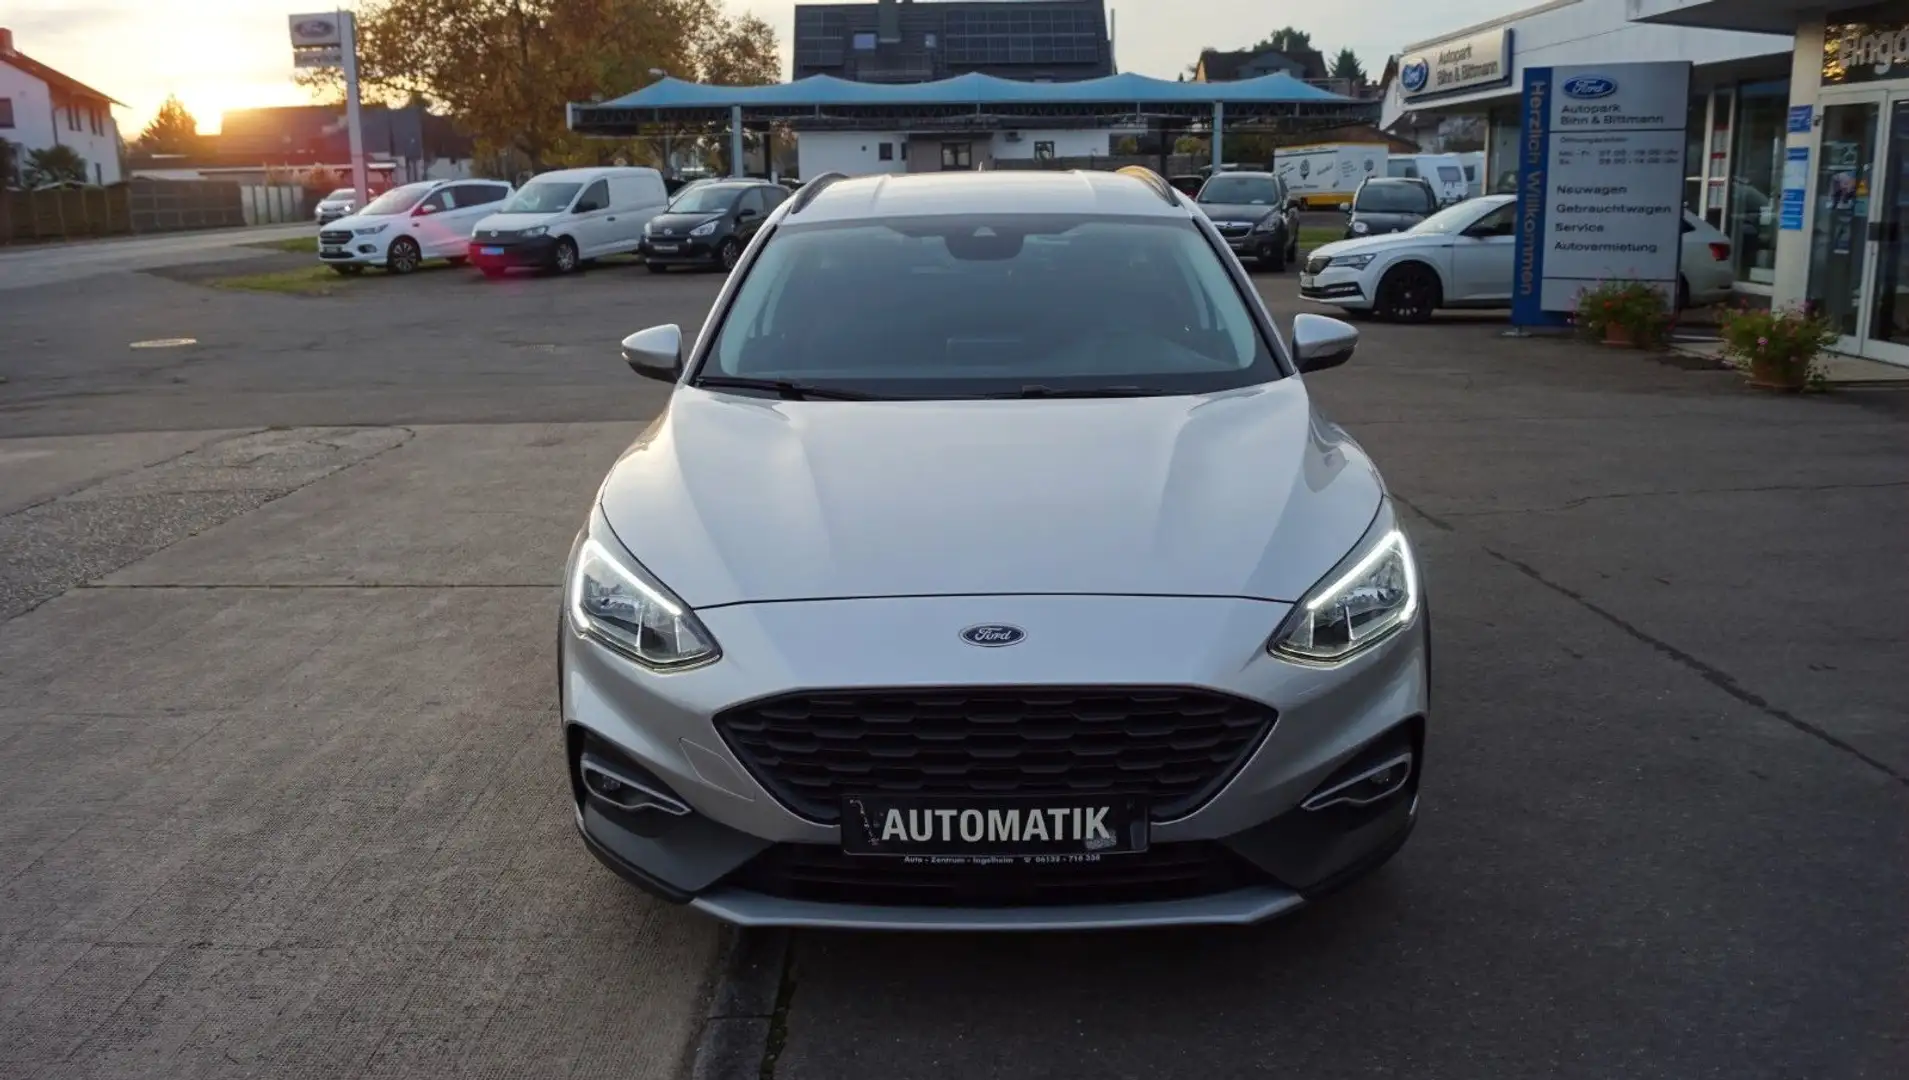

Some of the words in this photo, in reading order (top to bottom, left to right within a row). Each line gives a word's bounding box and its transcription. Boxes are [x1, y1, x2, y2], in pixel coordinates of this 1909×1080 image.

[1438, 43, 1472, 64] Autopark
[1572, 79, 1605, 94] Ford
[1561, 104, 1621, 115] Autopark
[1527, 80, 1547, 164] Herzlich
[1591, 115, 1600, 125] &
[1556, 185, 1628, 196] Neuwagen
[1556, 204, 1672, 215] Gebrauchtwagen
[1520, 169, 1541, 296] Willkommen
[1555, 223, 1604, 233] Service
[1554, 241, 1658, 253] Autovermietung
[974, 627, 1013, 641] Ford
[882, 806, 1111, 842] AUTOMATIK
